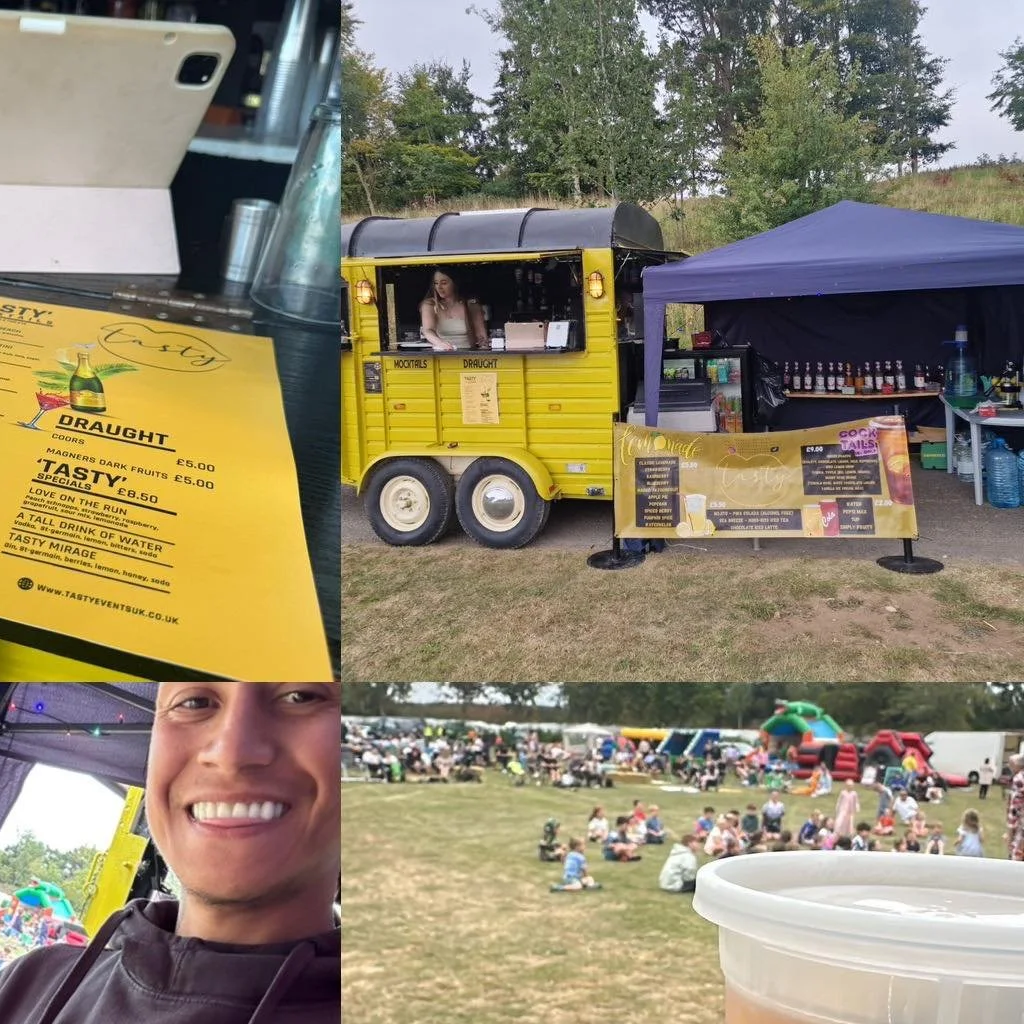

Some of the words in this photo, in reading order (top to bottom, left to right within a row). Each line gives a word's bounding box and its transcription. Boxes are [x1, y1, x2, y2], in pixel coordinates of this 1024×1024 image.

[100, 327, 220, 367] tasty
[393, 360, 428, 369] MOCKTAILS
[463, 359, 498, 369] DRAUGHT
[58, 414, 169, 445] DRAUGHT
[839, 428, 877, 438] COCK
[51, 433, 85, 445] COORS
[175, 458, 216, 473] £5.00
[46, 447, 96, 464] MAGNERS
[99, 458, 128, 471] DARK
[130, 465, 169, 480] FRUITS
[174, 474, 215, 490] £5.00
[717, 462, 787, 492] tasty
[29, 487, 56, 499] LOVE
[60, 494, 77, 504] ON
[79, 498, 100, 509] THE
[103, 503, 128, 516] RUN
[37, 472, 92, 491] SPECIALS
[117, 487, 159, 504] £8.50
[23, 500, 59, 512] grapefruit,
[77, 512, 92, 520] mix,
[81, 508, 121, 521] strawberry,
[122, 517, 160, 531] raspberry,
[8, 532, 46, 547] TASTY
[49, 542, 97, 559] MIRAGE
[14, 520, 37, 529] Vodka,
[84, 535, 108, 546] lemon,
[110, 542, 138, 553] bitters,
[139, 550, 158, 558] soda
[16, 512, 25, 521] A
[28, 514, 55, 527] TALL
[59, 521, 96, 537] DRINK
[99, 530, 115, 540] OF
[119, 535, 163, 552] WATER
[64, 556, 93, 568] berries,
[95, 563, 121, 575] lemon,
[122, 570, 149, 582] honey,
[150, 578, 171, 587] soda
